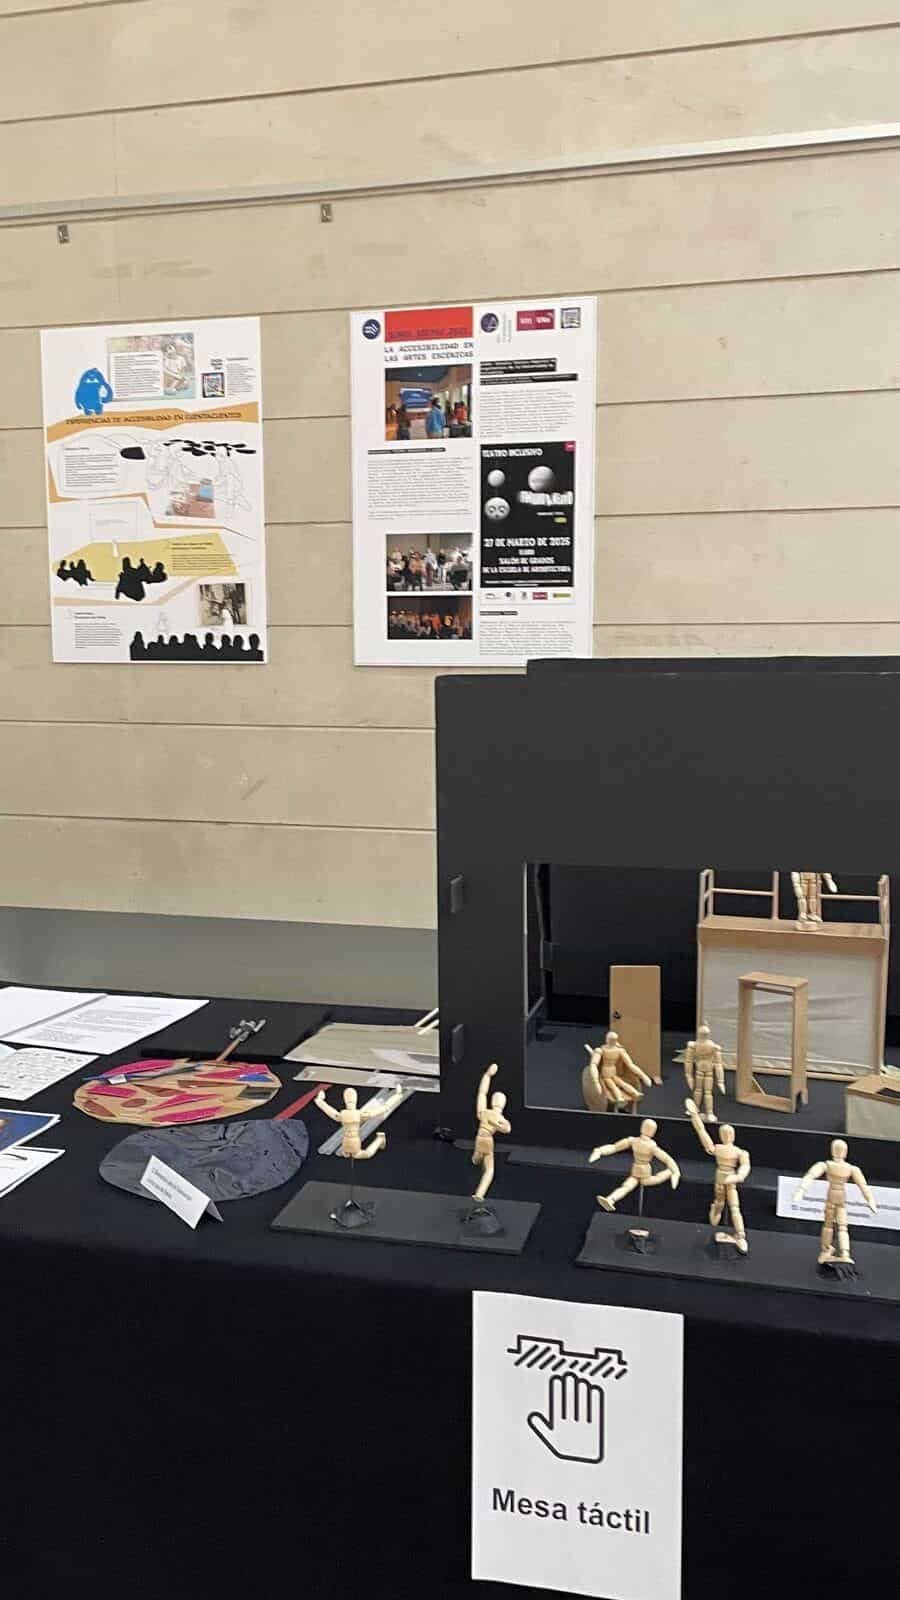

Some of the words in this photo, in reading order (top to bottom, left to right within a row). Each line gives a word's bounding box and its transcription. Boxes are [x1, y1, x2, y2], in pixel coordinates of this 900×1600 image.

[507, 537, 536, 548] MARZO
[492, 1487, 568, 1521] Mesa
[577, 1502, 650, 1534] táctil
